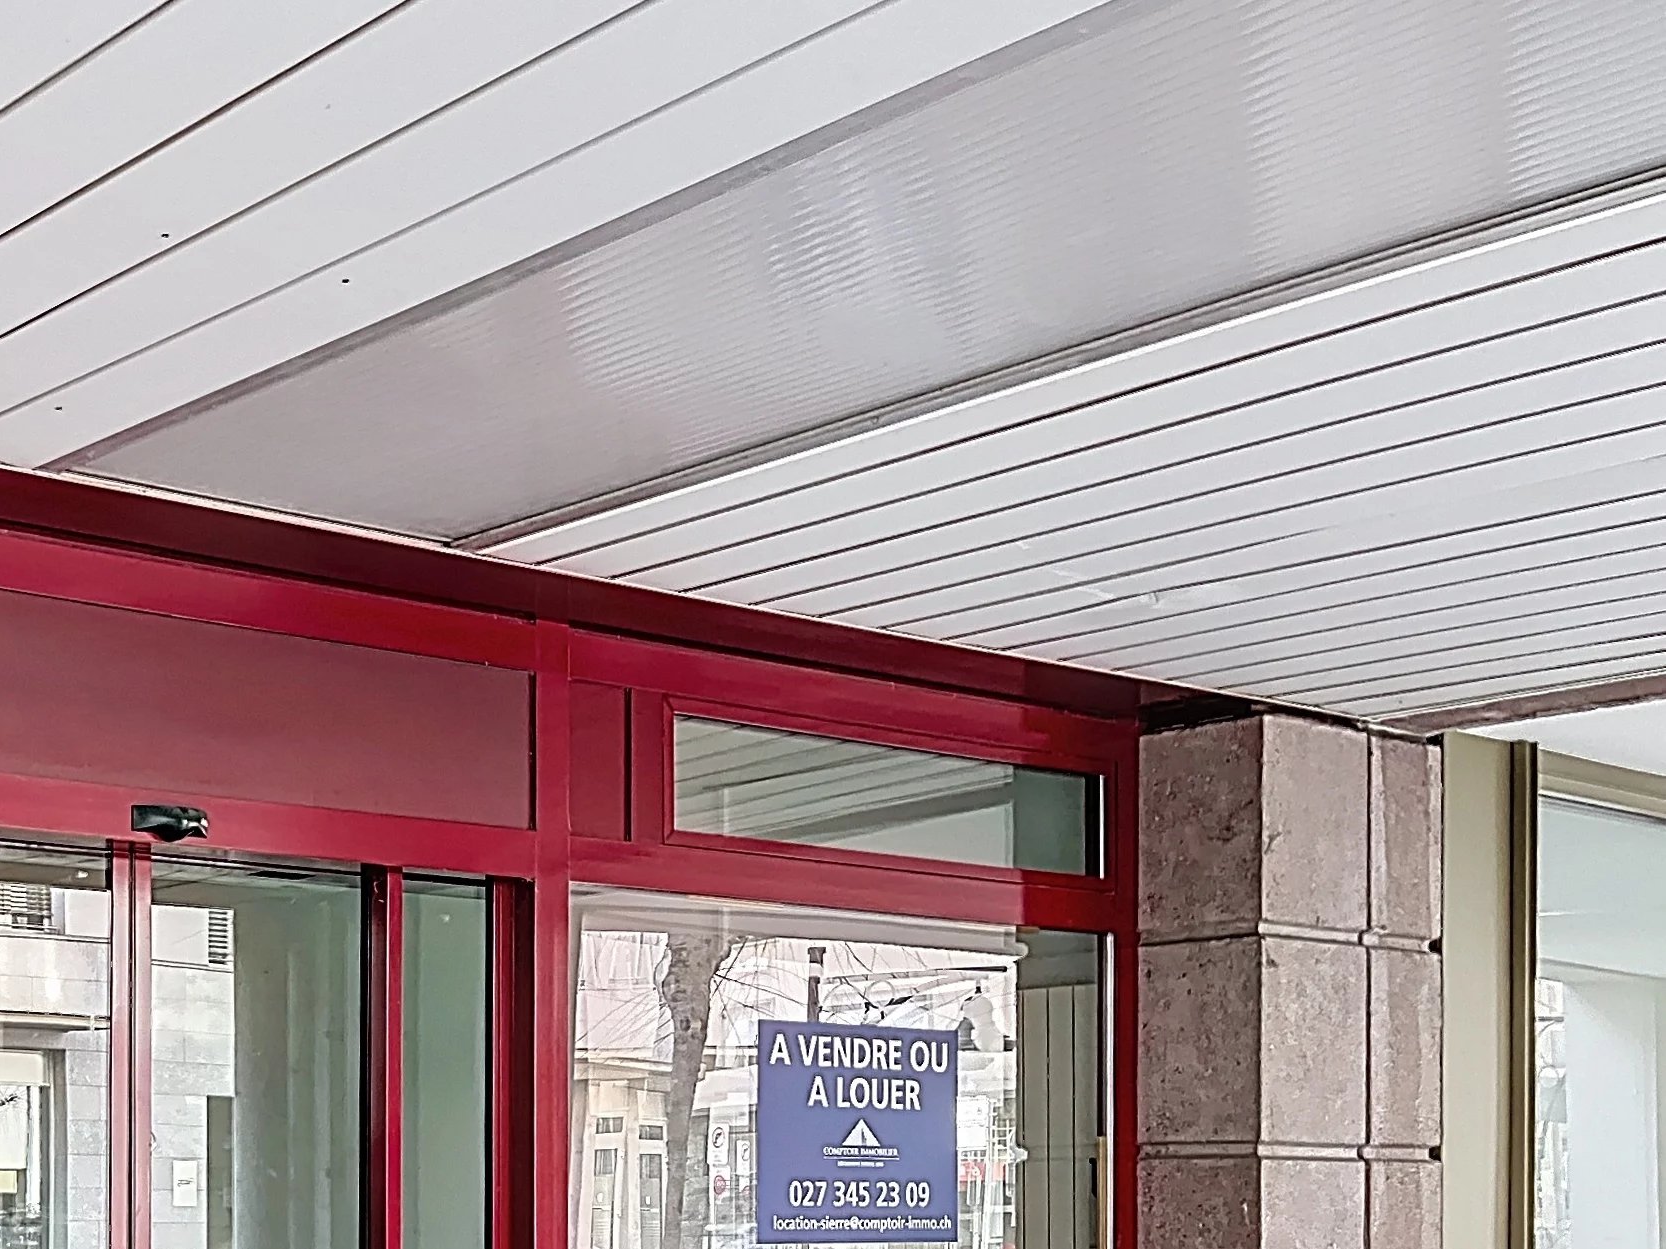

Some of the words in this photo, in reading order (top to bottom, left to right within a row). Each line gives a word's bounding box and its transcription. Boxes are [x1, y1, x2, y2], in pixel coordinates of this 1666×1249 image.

[769, 1033, 792, 1066] A
[797, 1034, 903, 1072] VENDRE
[910, 1040, 949, 1073] OU
[807, 1075, 829, 1108] A
[836, 1076, 921, 1111] LOUER
[789, 1180, 828, 1208] 027
[833, 1181, 870, 1208] 345
[875, 1181, 900, 1208] 23
[905, 1181, 931, 1209] 09
[772, 1214, 952, 1234] location-sierre@comptoir-immo.ch
